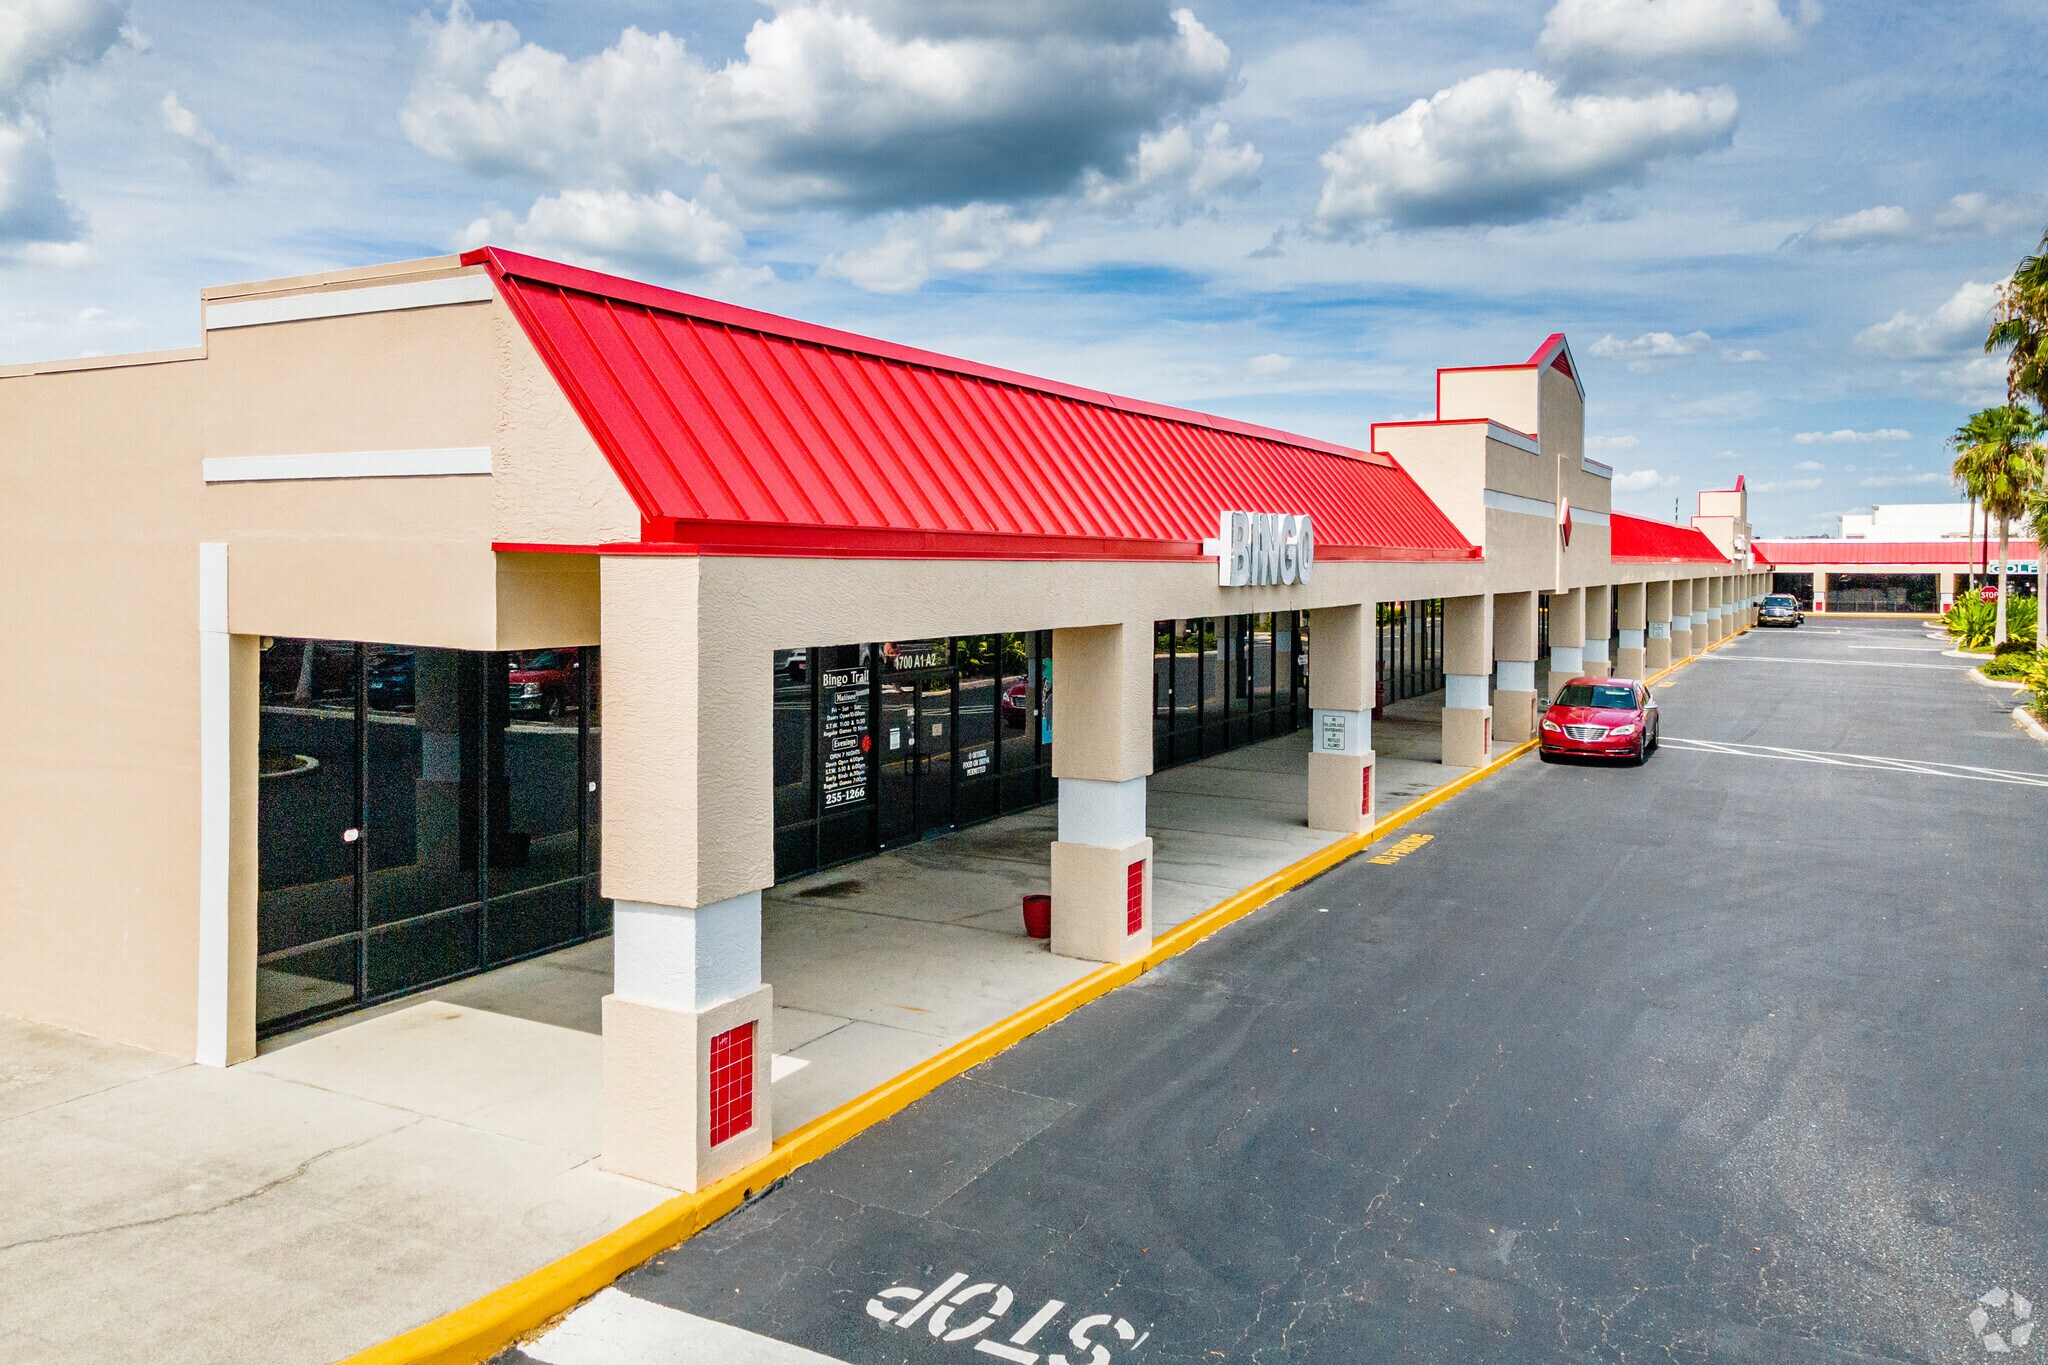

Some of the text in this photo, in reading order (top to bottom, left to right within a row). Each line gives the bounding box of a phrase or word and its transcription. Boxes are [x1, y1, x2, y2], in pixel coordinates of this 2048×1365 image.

[1220, 510, 1314, 586] BINGO
[894, 655, 913, 670] 1700
[823, 670, 869, 687] Bingo Trail
[834, 739, 857, 748] Evenings
[826, 787, 865, 804] 255-1266
[866, 1272, 1136, 1365] STOP
